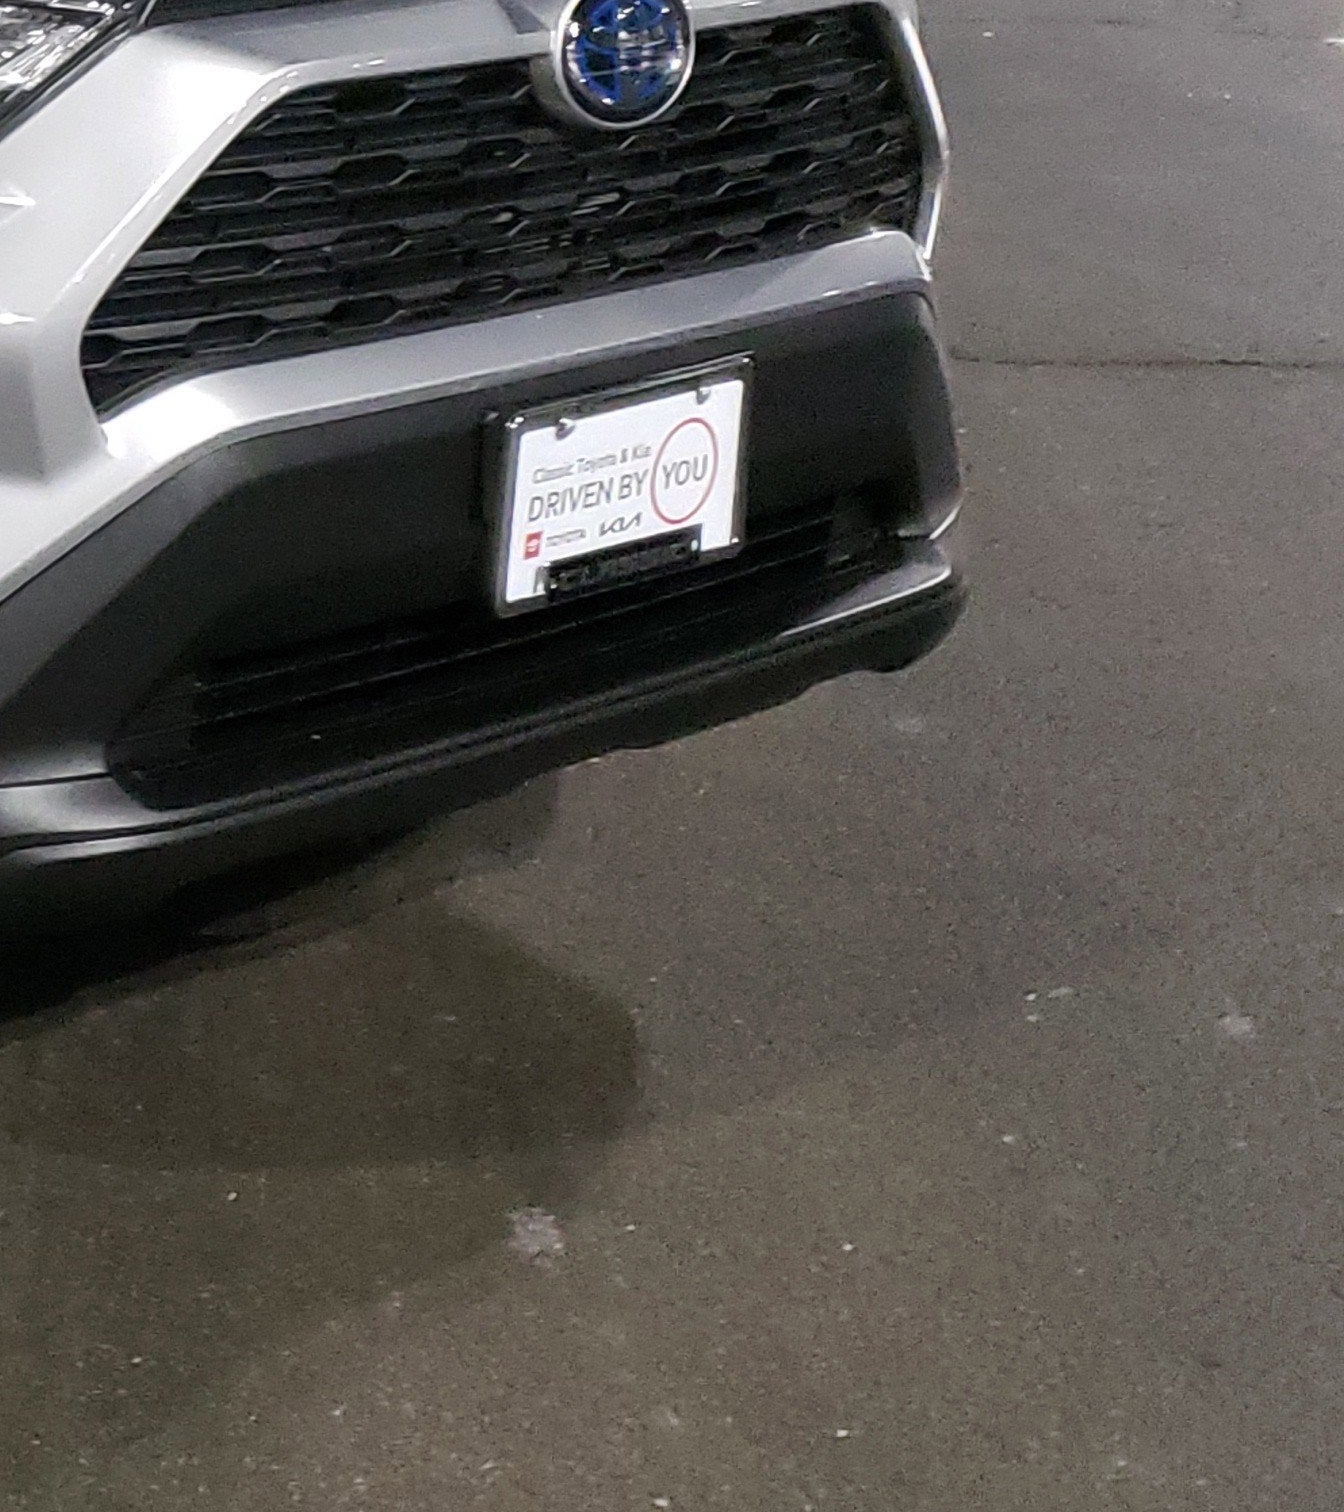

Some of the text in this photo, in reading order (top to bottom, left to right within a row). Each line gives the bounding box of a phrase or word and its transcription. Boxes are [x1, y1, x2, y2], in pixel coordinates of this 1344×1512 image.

[528, 453, 708, 522] DRIVEN BY YOU
